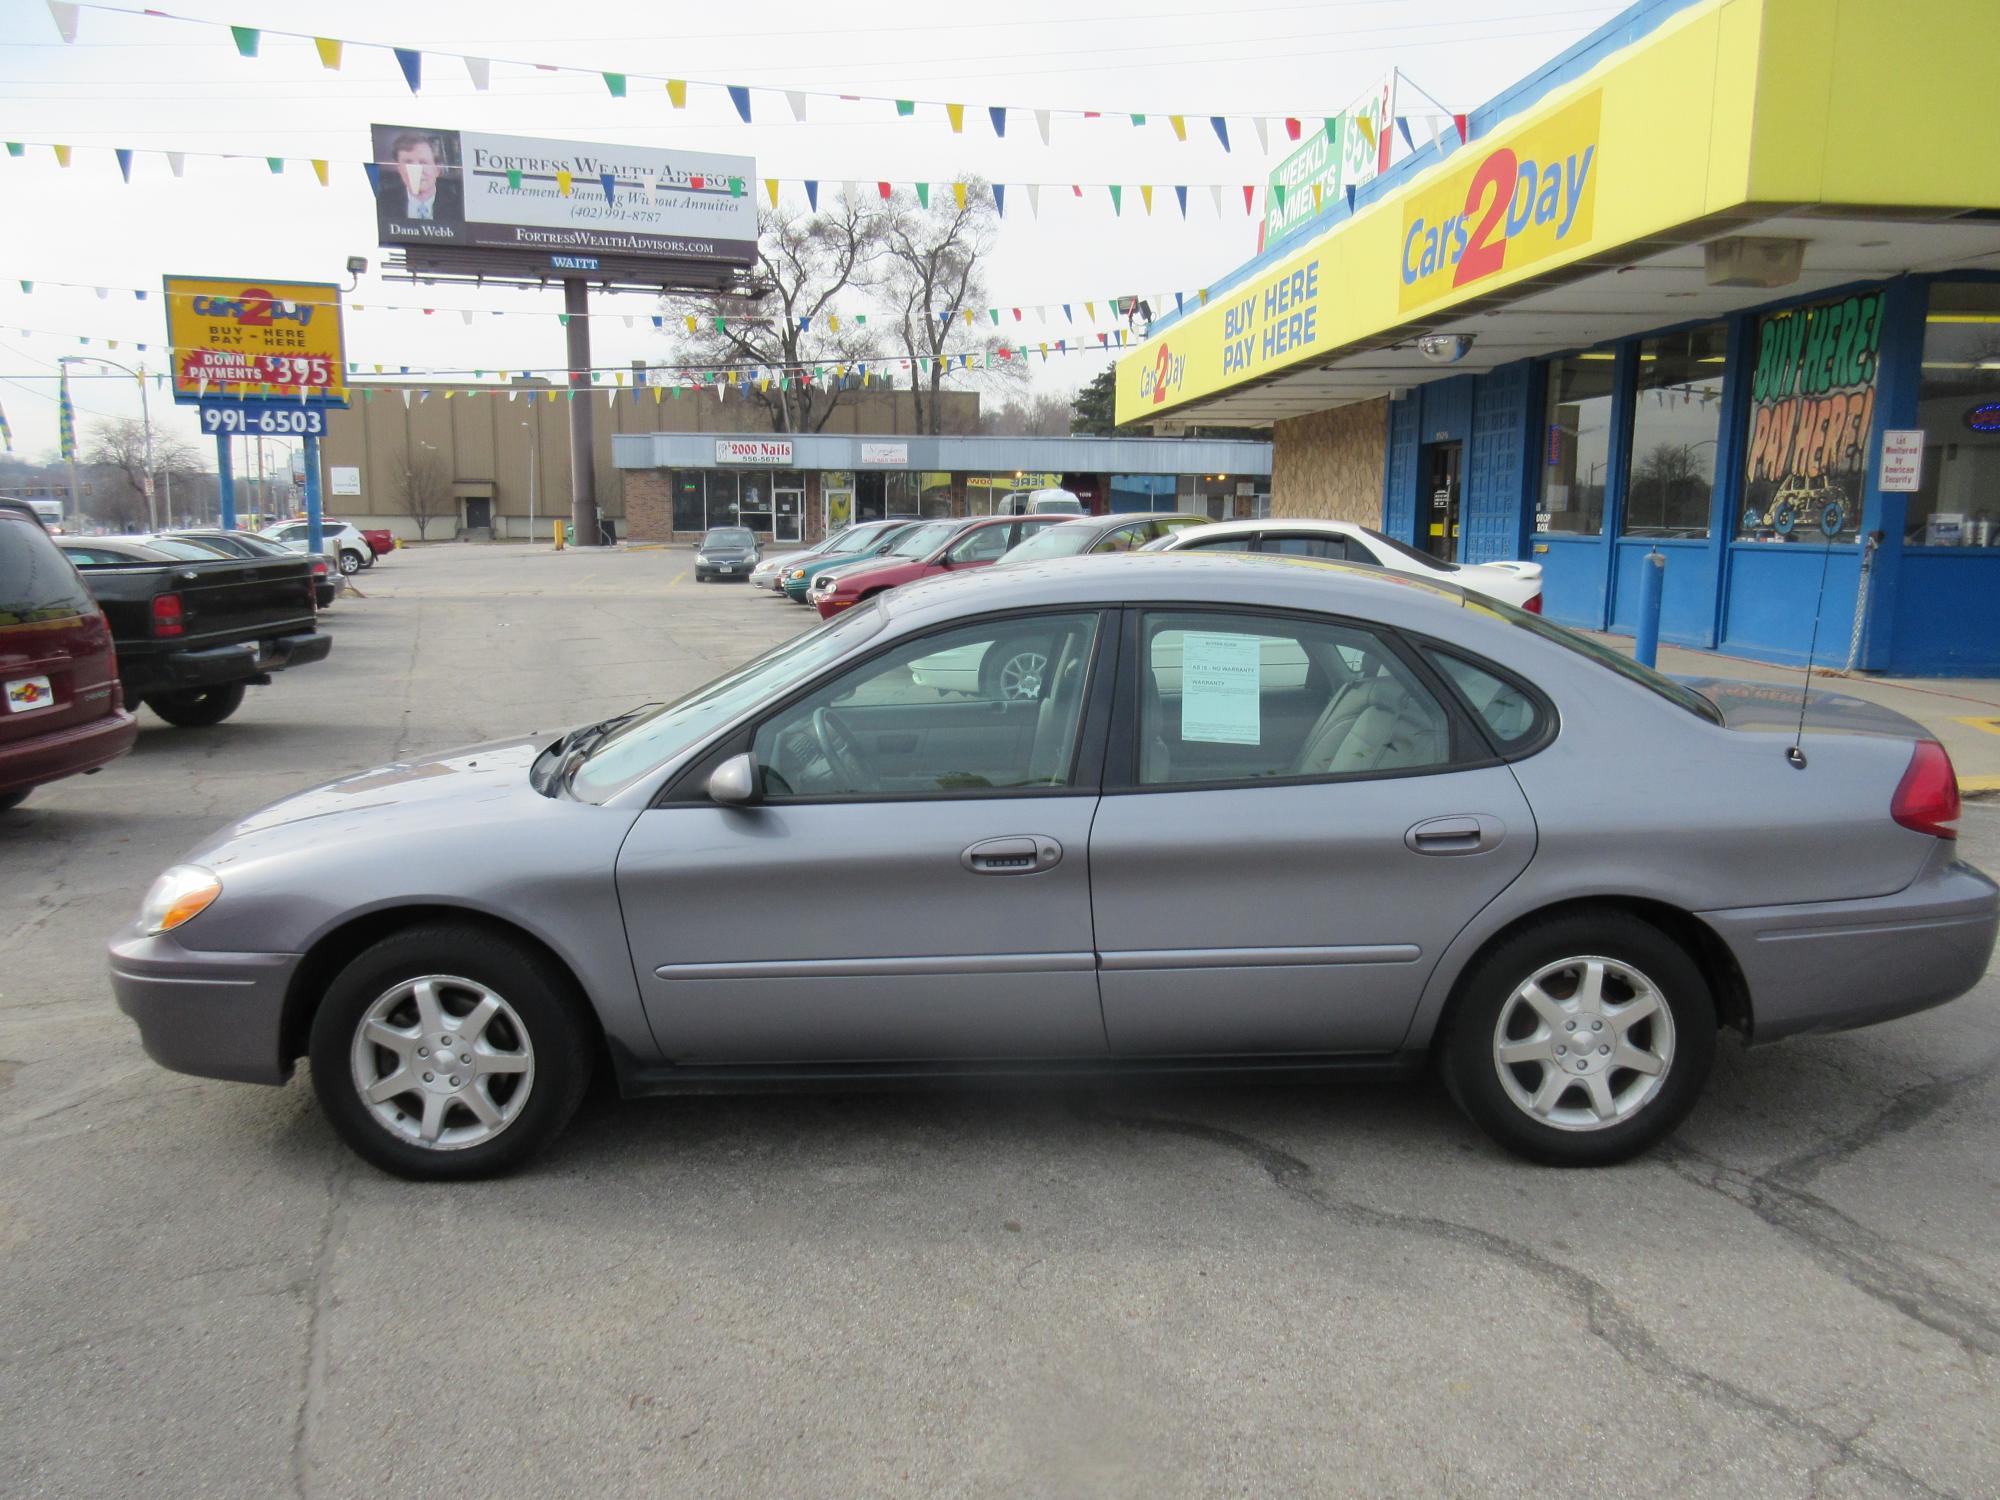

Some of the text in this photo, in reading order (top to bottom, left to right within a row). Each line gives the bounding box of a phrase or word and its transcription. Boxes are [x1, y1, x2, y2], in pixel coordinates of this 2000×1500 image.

[1279, 134, 1329, 189] WEEKLY
[680, 196, 739, 213] Annuities
[390, 224, 455, 238] Dana Webb
[553, 256, 598, 270] WAITT
[1224, 260, 1320, 341] BUY HERE
[209, 326, 305, 338] BUY HERE
[210, 335, 306, 347] PAY HERE
[1223, 305, 1317, 376] PAY HERE
[1753, 290, 1887, 403] BUY HERE!
[204, 354, 245, 366] DOWN
[190, 366, 262, 380] PAYMENTS
[205, 409, 322, 433] 991-6503
[1747, 385, 1876, 483] PAY HERE!
[761, 443, 791, 455] Nails
[1884, 476, 1912, 484] Security
[1536, 513, 1551, 522] DROP
[1536, 523, 1549, 532] BOX
